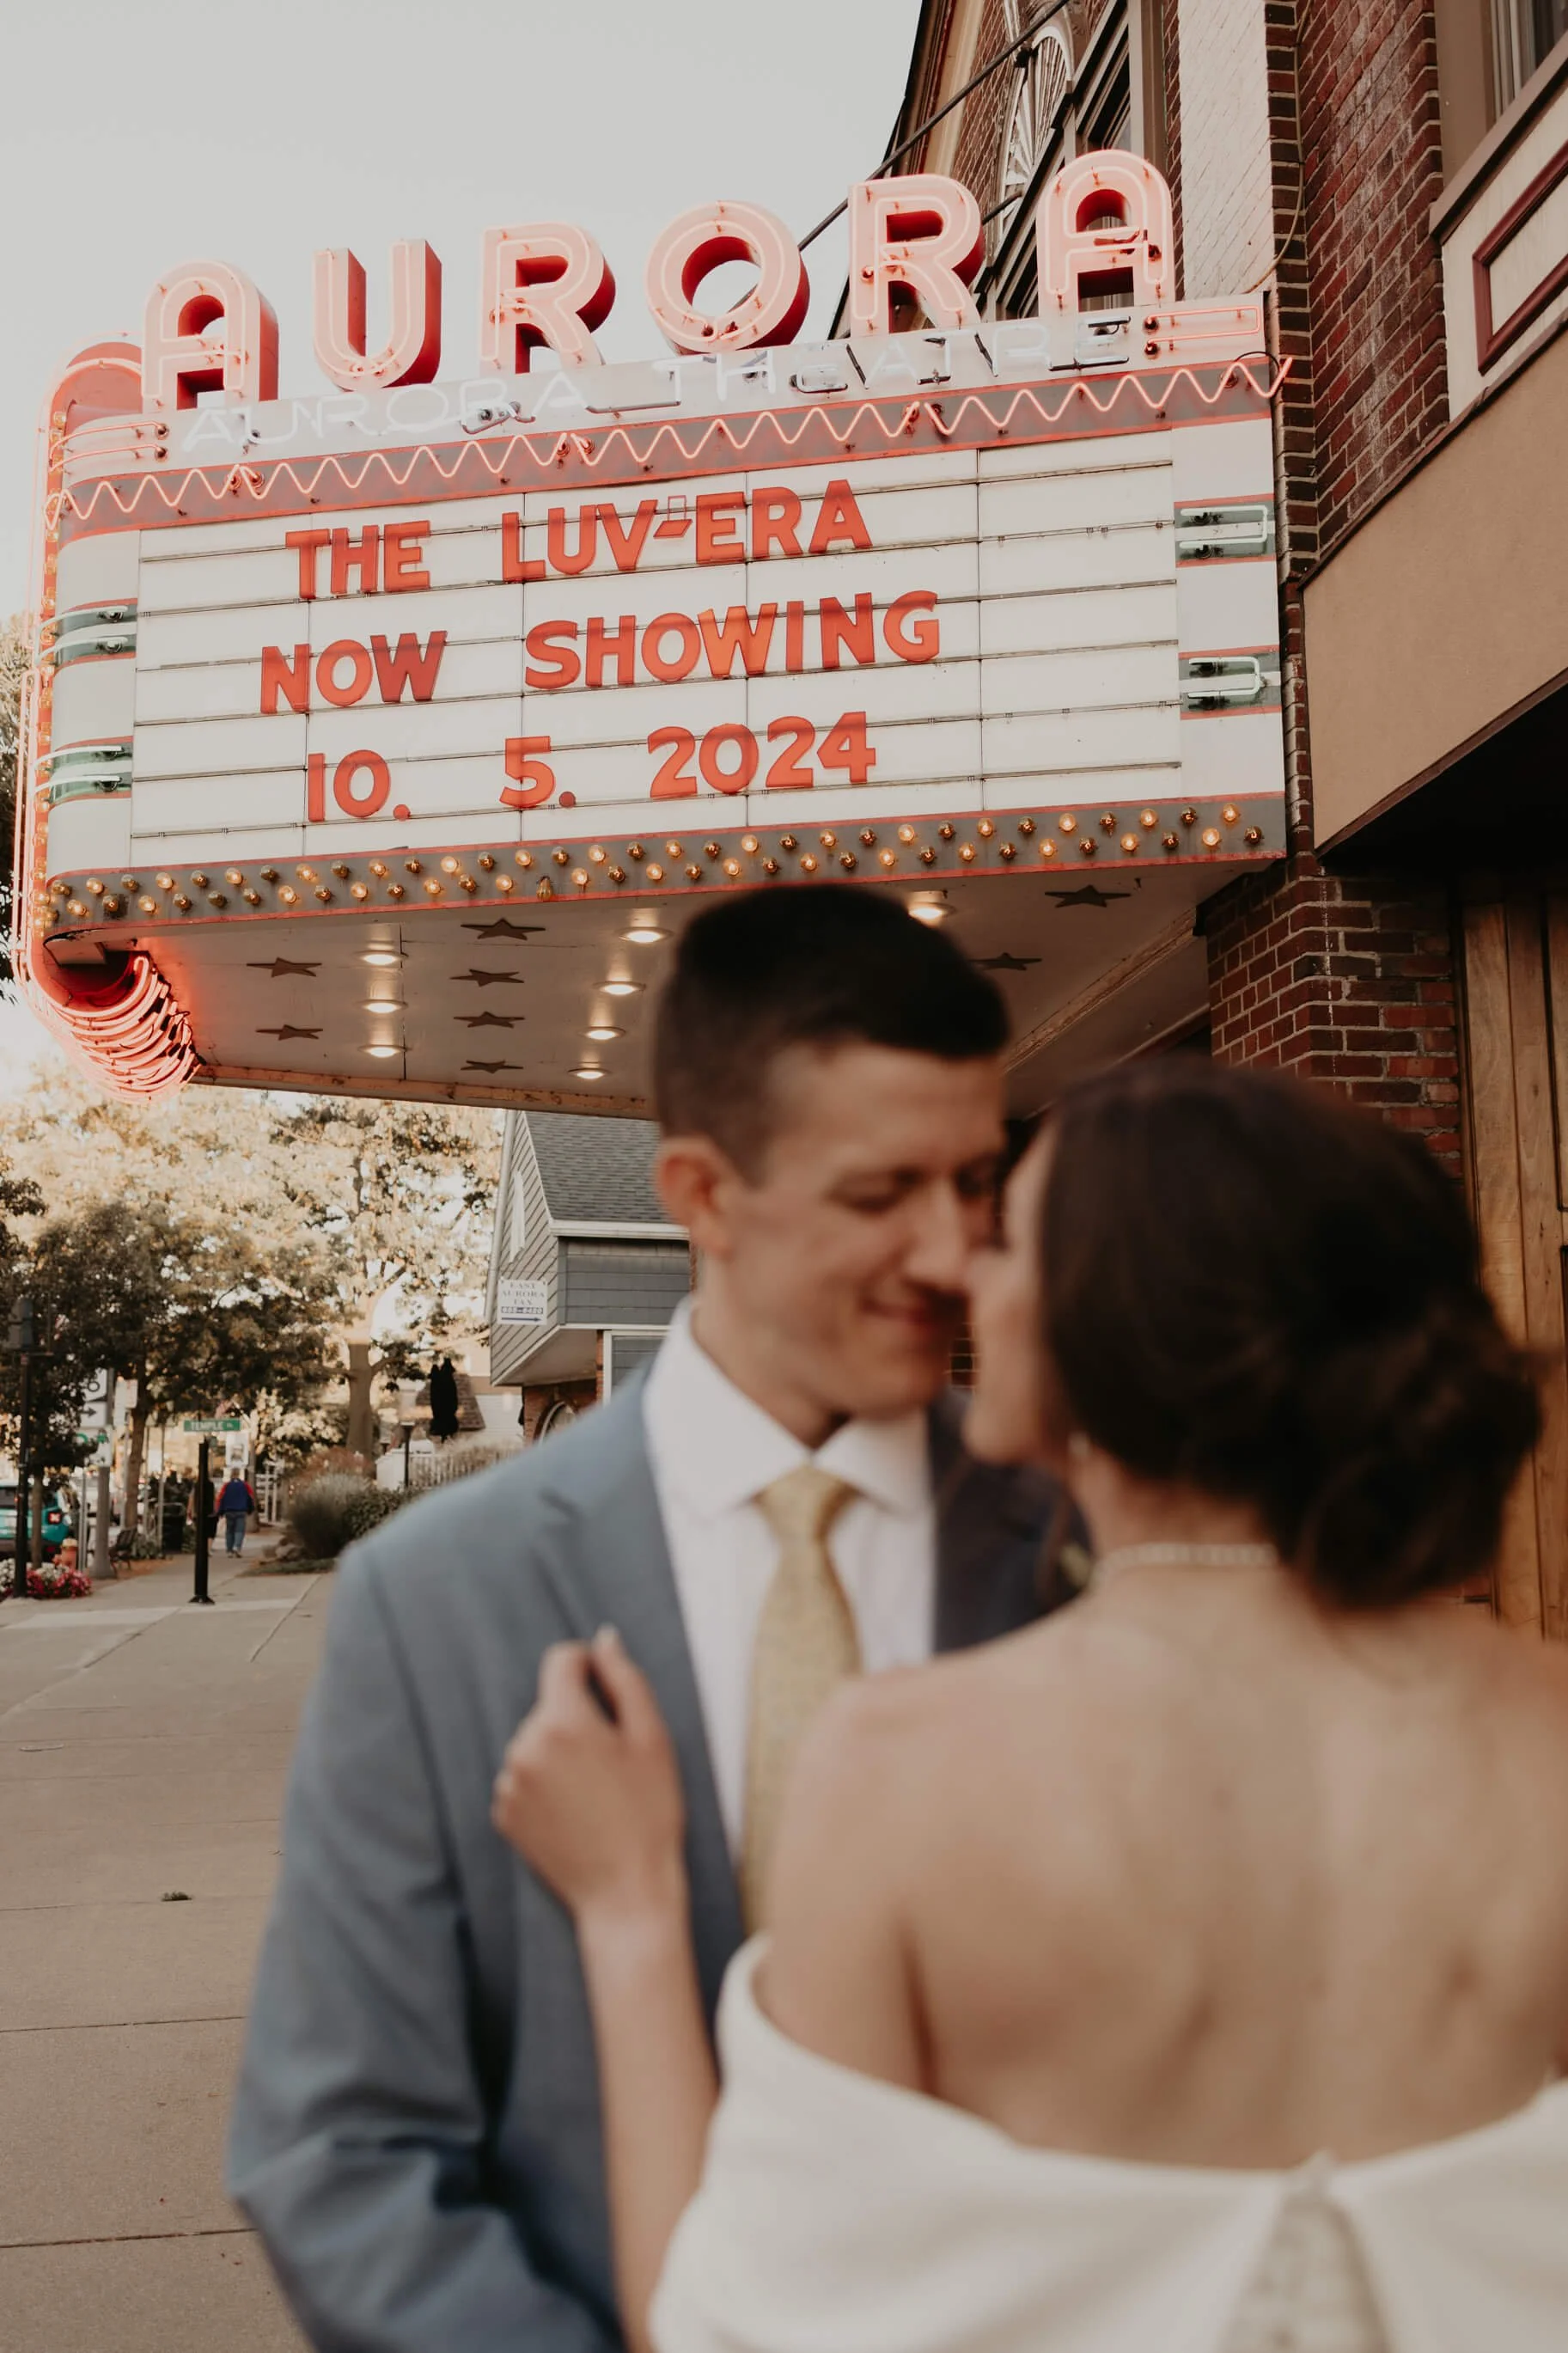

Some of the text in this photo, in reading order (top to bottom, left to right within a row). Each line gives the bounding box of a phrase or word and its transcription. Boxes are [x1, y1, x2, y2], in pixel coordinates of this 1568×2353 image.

[140, 149, 1175, 414] AURORA
[183, 315, 1132, 452] AURORA THEATRE
[285, 479, 874, 600] THE LUV-ERA
[259, 590, 940, 715] NOW SHOWING
[307, 711, 876, 823] 10. 5. 2024
[502, 1289, 546, 1299] AURORA
[190, 1421, 224, 1431] TEMPLE
